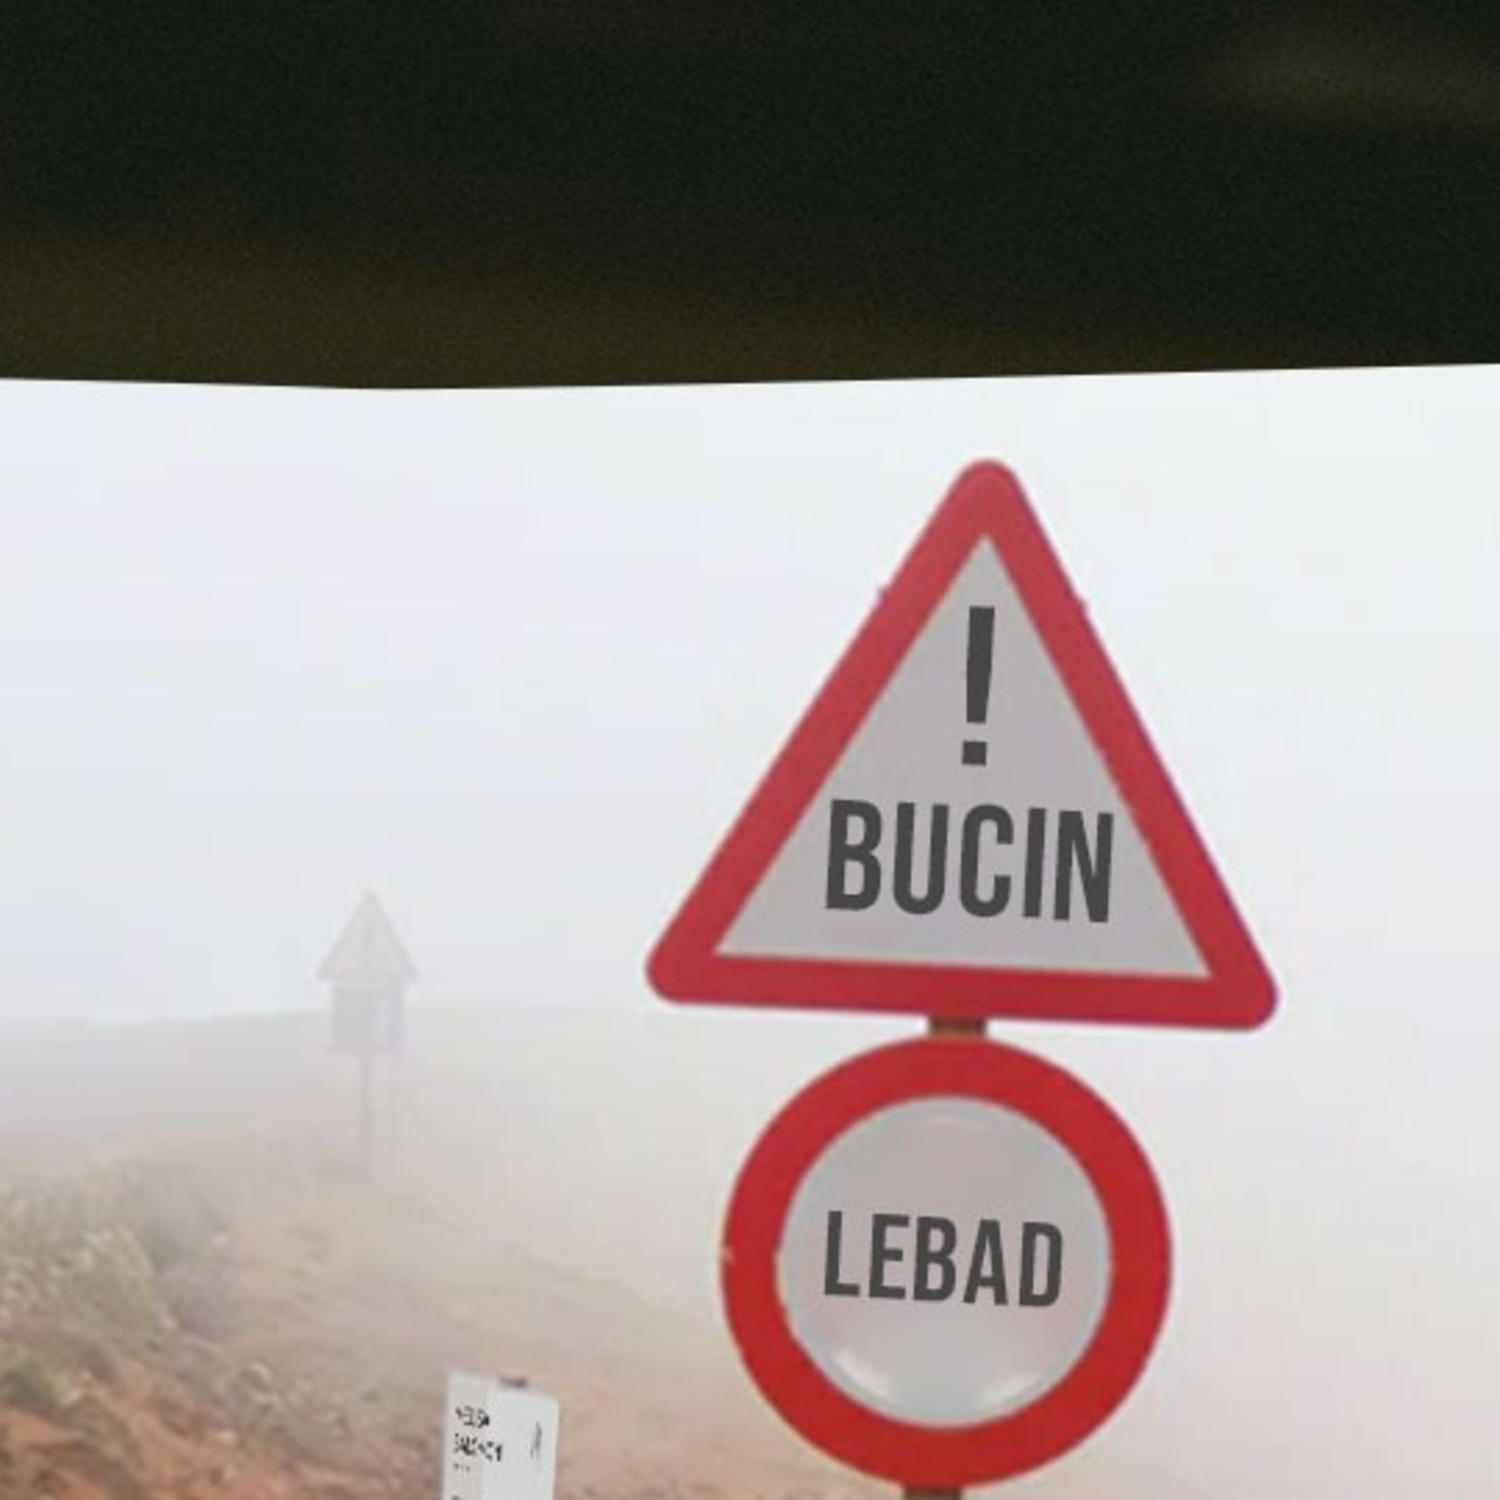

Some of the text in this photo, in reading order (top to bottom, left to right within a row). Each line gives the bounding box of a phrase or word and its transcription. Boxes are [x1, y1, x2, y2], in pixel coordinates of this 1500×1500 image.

[961, 606, 995, 765] !
[825, 799, 1114, 923] BUCIN
[823, 1210, 1064, 1307] LEBAD
